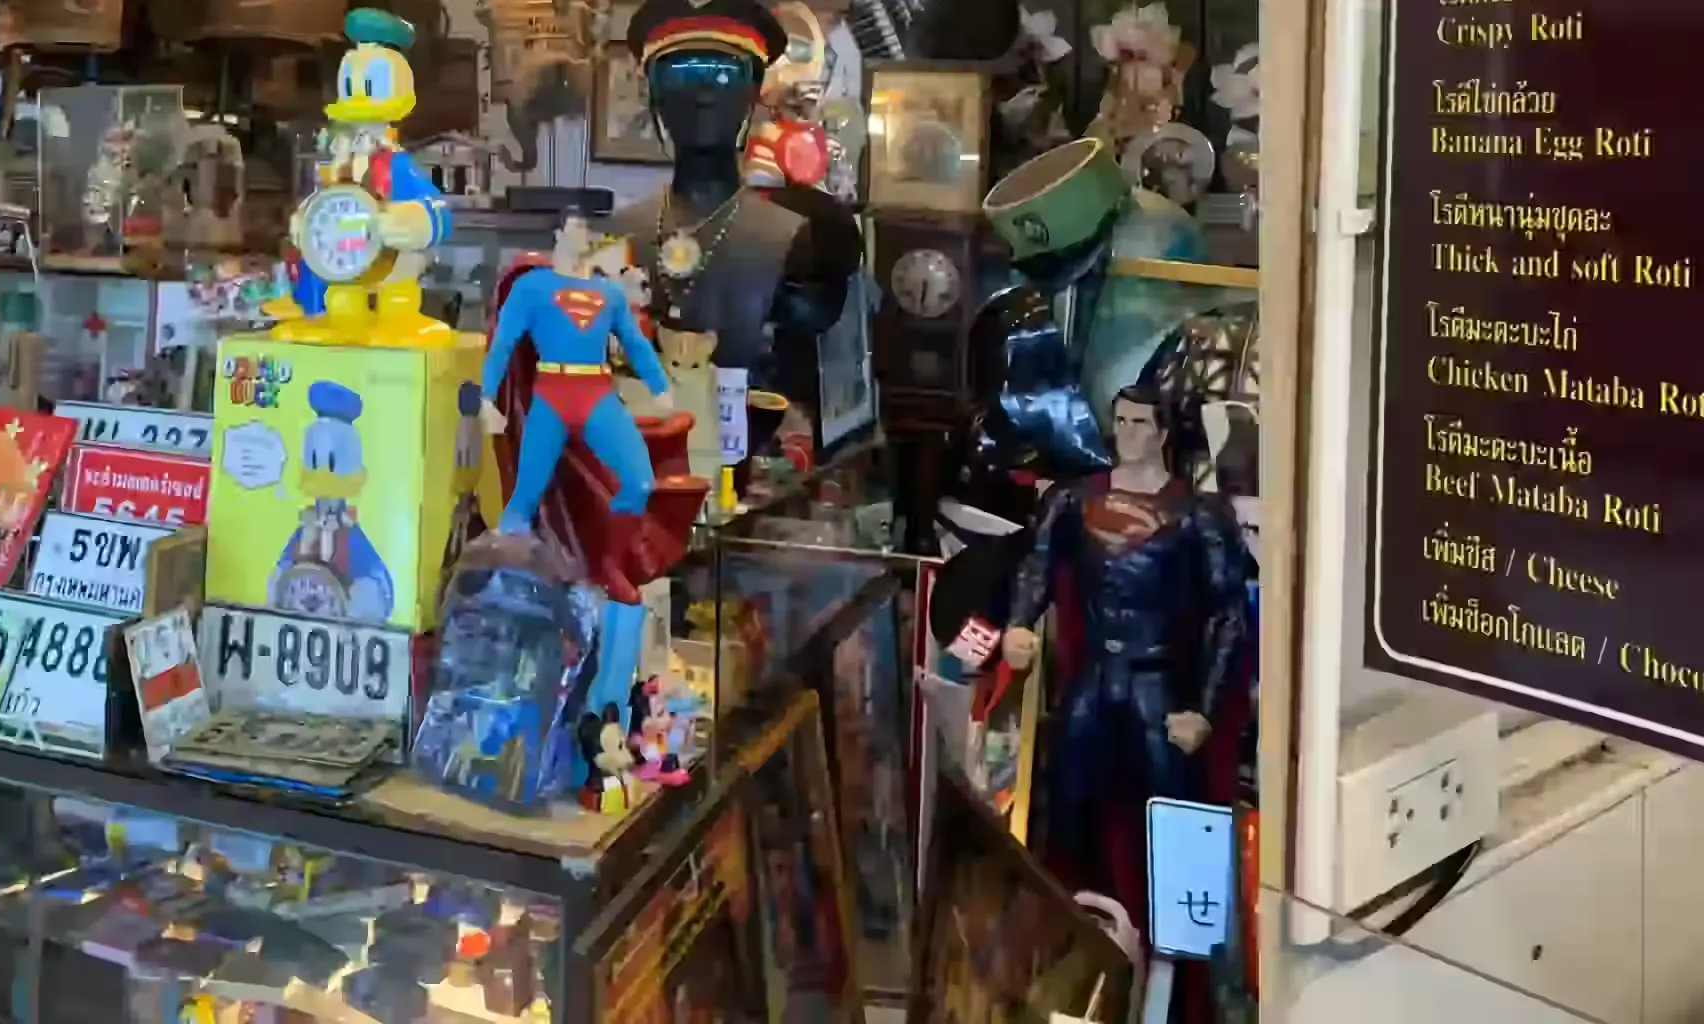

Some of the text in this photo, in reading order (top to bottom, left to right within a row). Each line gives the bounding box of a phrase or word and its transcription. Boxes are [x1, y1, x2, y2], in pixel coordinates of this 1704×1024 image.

[1437, 10, 1583, 49] Crispy Roti
[1432, 127, 1652, 160] Banana Egg Roti
[1432, 243, 1691, 289] Thick and soft Roti
[1427, 354, 1529, 393] Chicken
[1544, 367, 1644, 410] Mataba
[1426, 462, 1662, 534] Beef Mataba Roti
[1527, 551, 1622, 600] Cheese
[1177, 890, 1220, 926] せ
